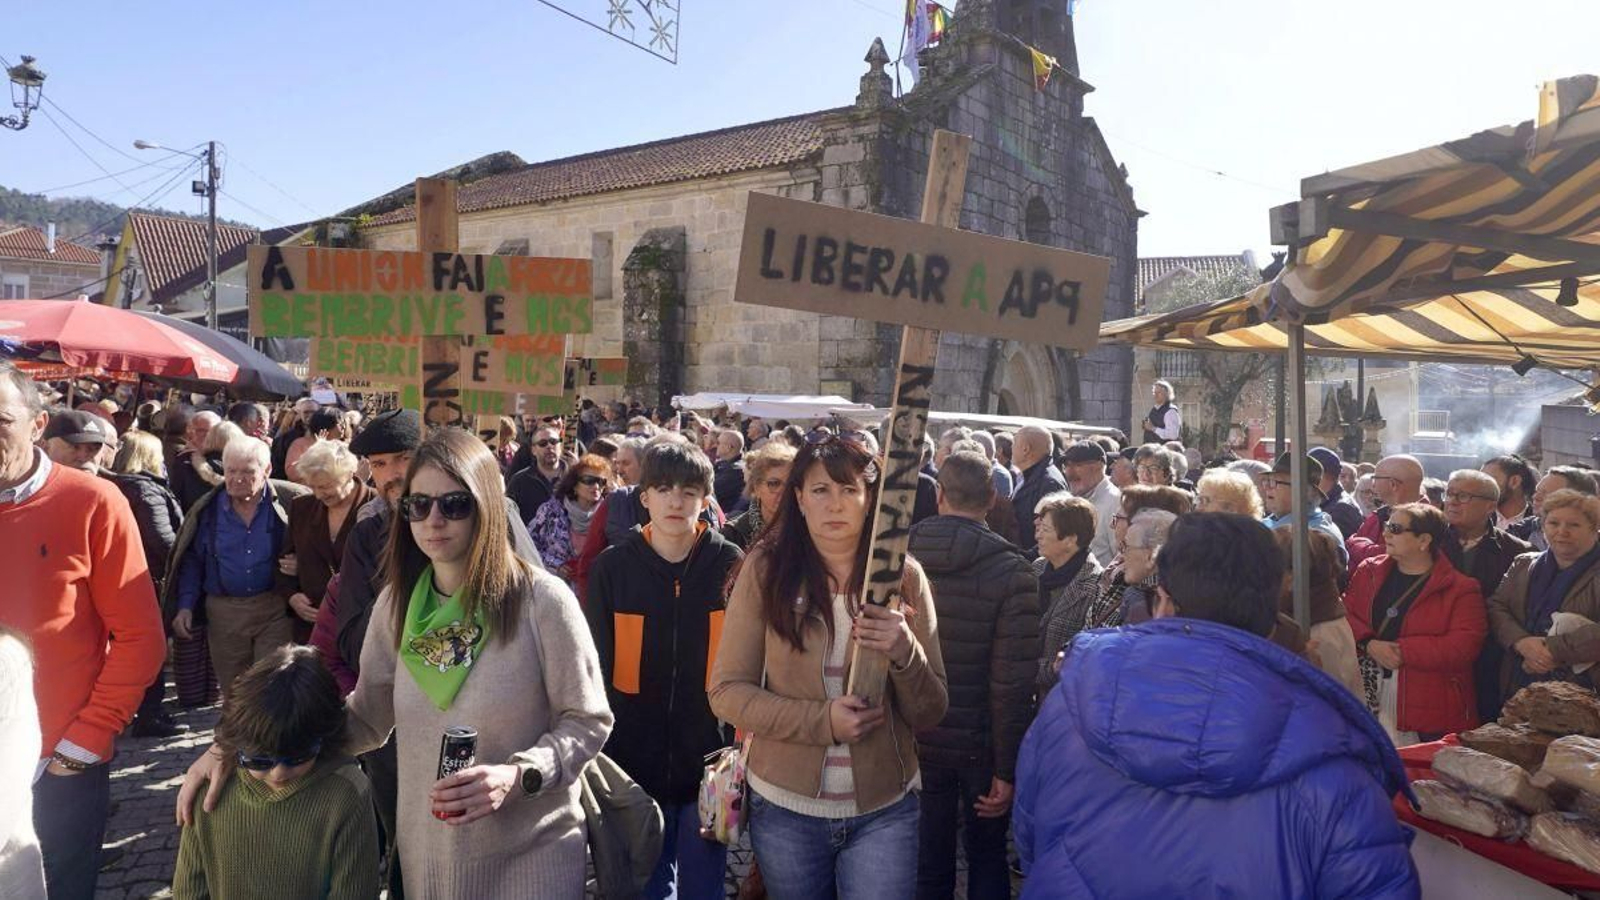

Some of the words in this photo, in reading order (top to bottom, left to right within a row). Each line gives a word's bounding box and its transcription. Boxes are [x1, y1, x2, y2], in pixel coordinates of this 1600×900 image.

[261, 246, 295, 290] A
[307, 247, 424, 292] UNION
[432, 253, 485, 292] FAI
[486, 255, 511, 293] A
[760, 228, 950, 304] LIBERAR
[961, 258, 989, 312] A
[484, 294, 505, 335] E
[472, 350, 489, 382] E
